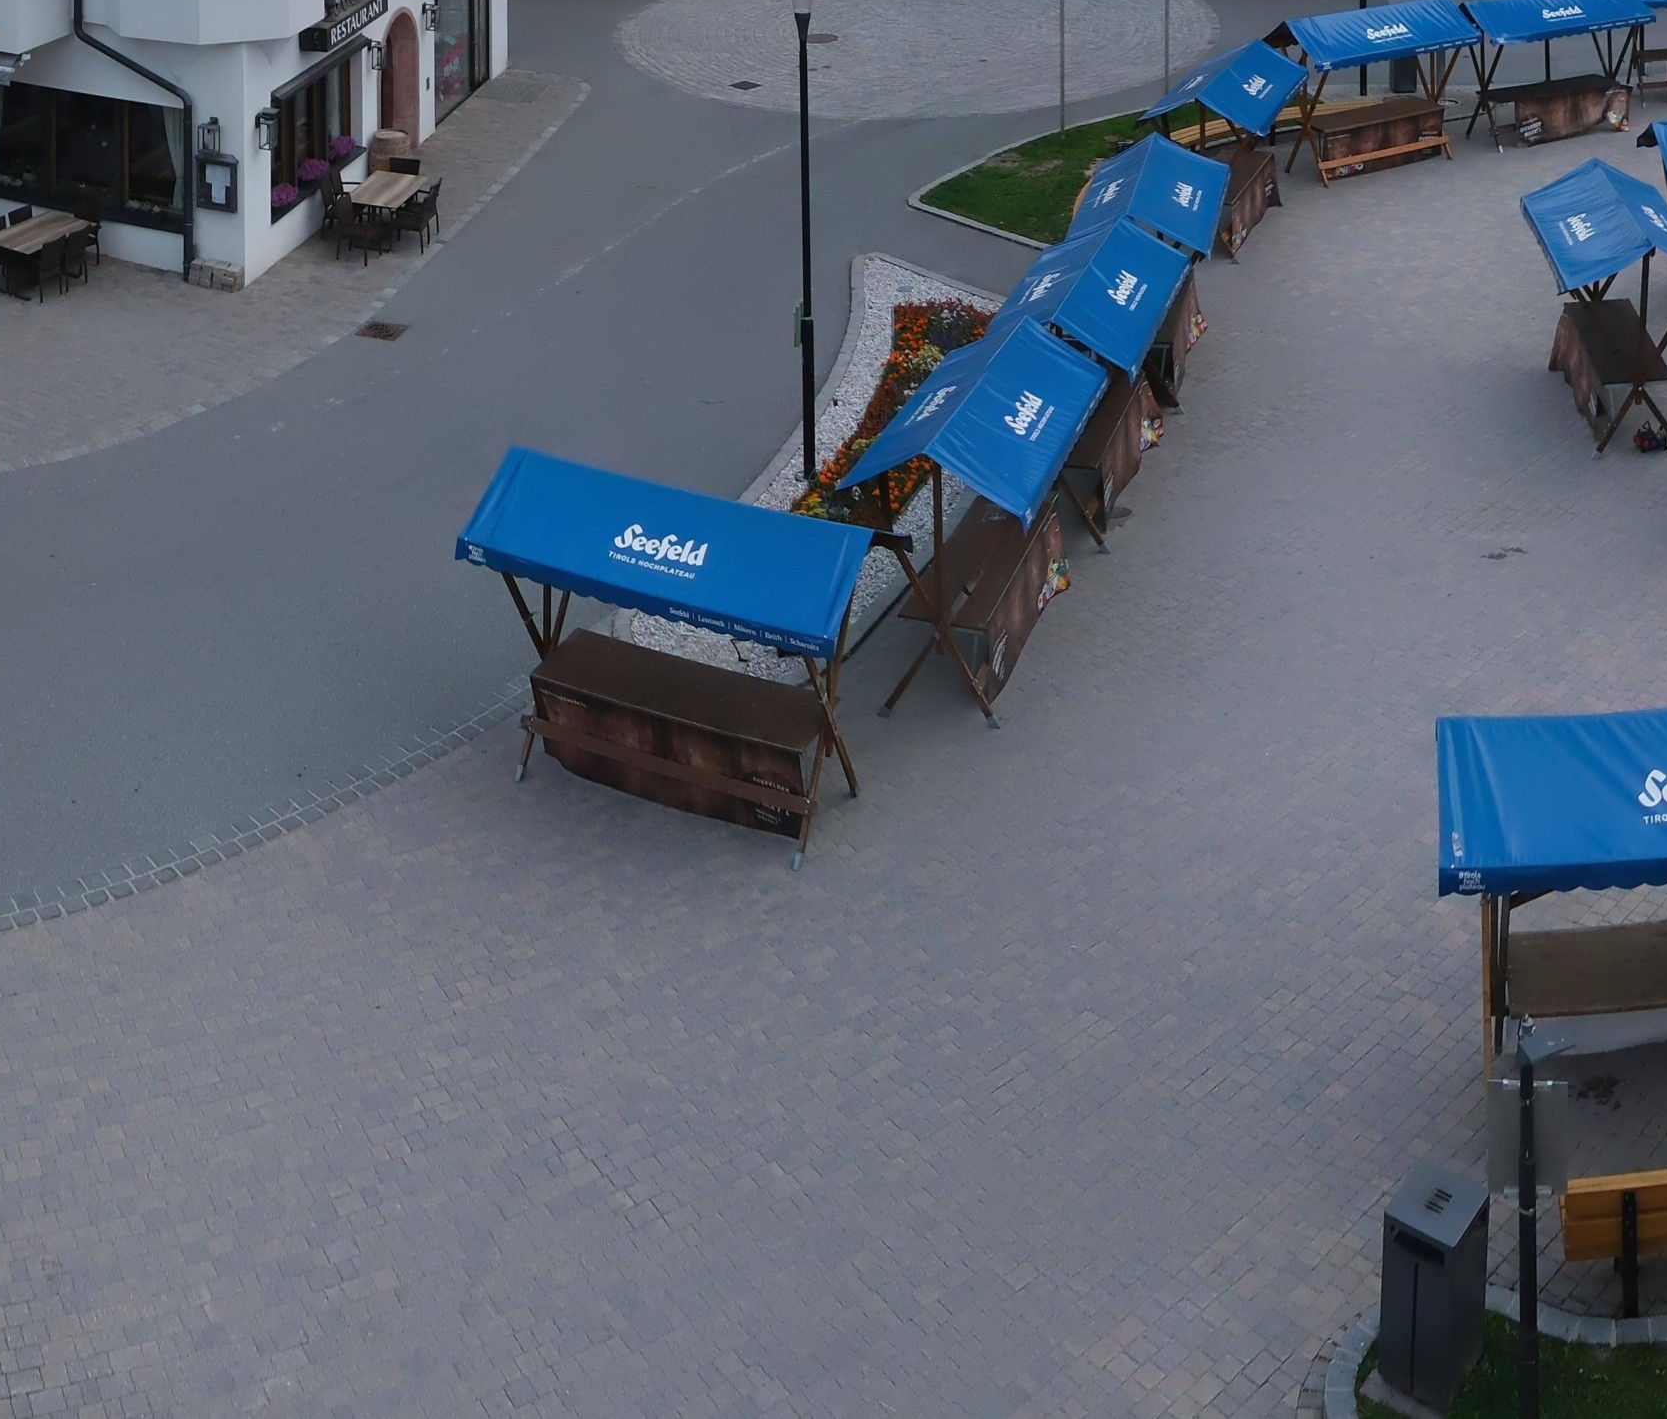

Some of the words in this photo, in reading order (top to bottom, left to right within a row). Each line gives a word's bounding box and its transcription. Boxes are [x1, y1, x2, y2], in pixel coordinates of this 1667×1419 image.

[1541, 5, 1583, 20] Seefeld
[1366, 23, 1408, 41] Seefeld
[1107, 269, 1138, 306] Seefeld
[1003, 390, 1043, 435] Seefeld
[614, 523, 709, 567] Seefeld
[608, 550, 636, 565] TIROLS
[637, 559, 696, 579] HOCHPLATEAU
[669, 606, 690, 619] Seefeld
[697, 613, 725, 628] Leutasch
